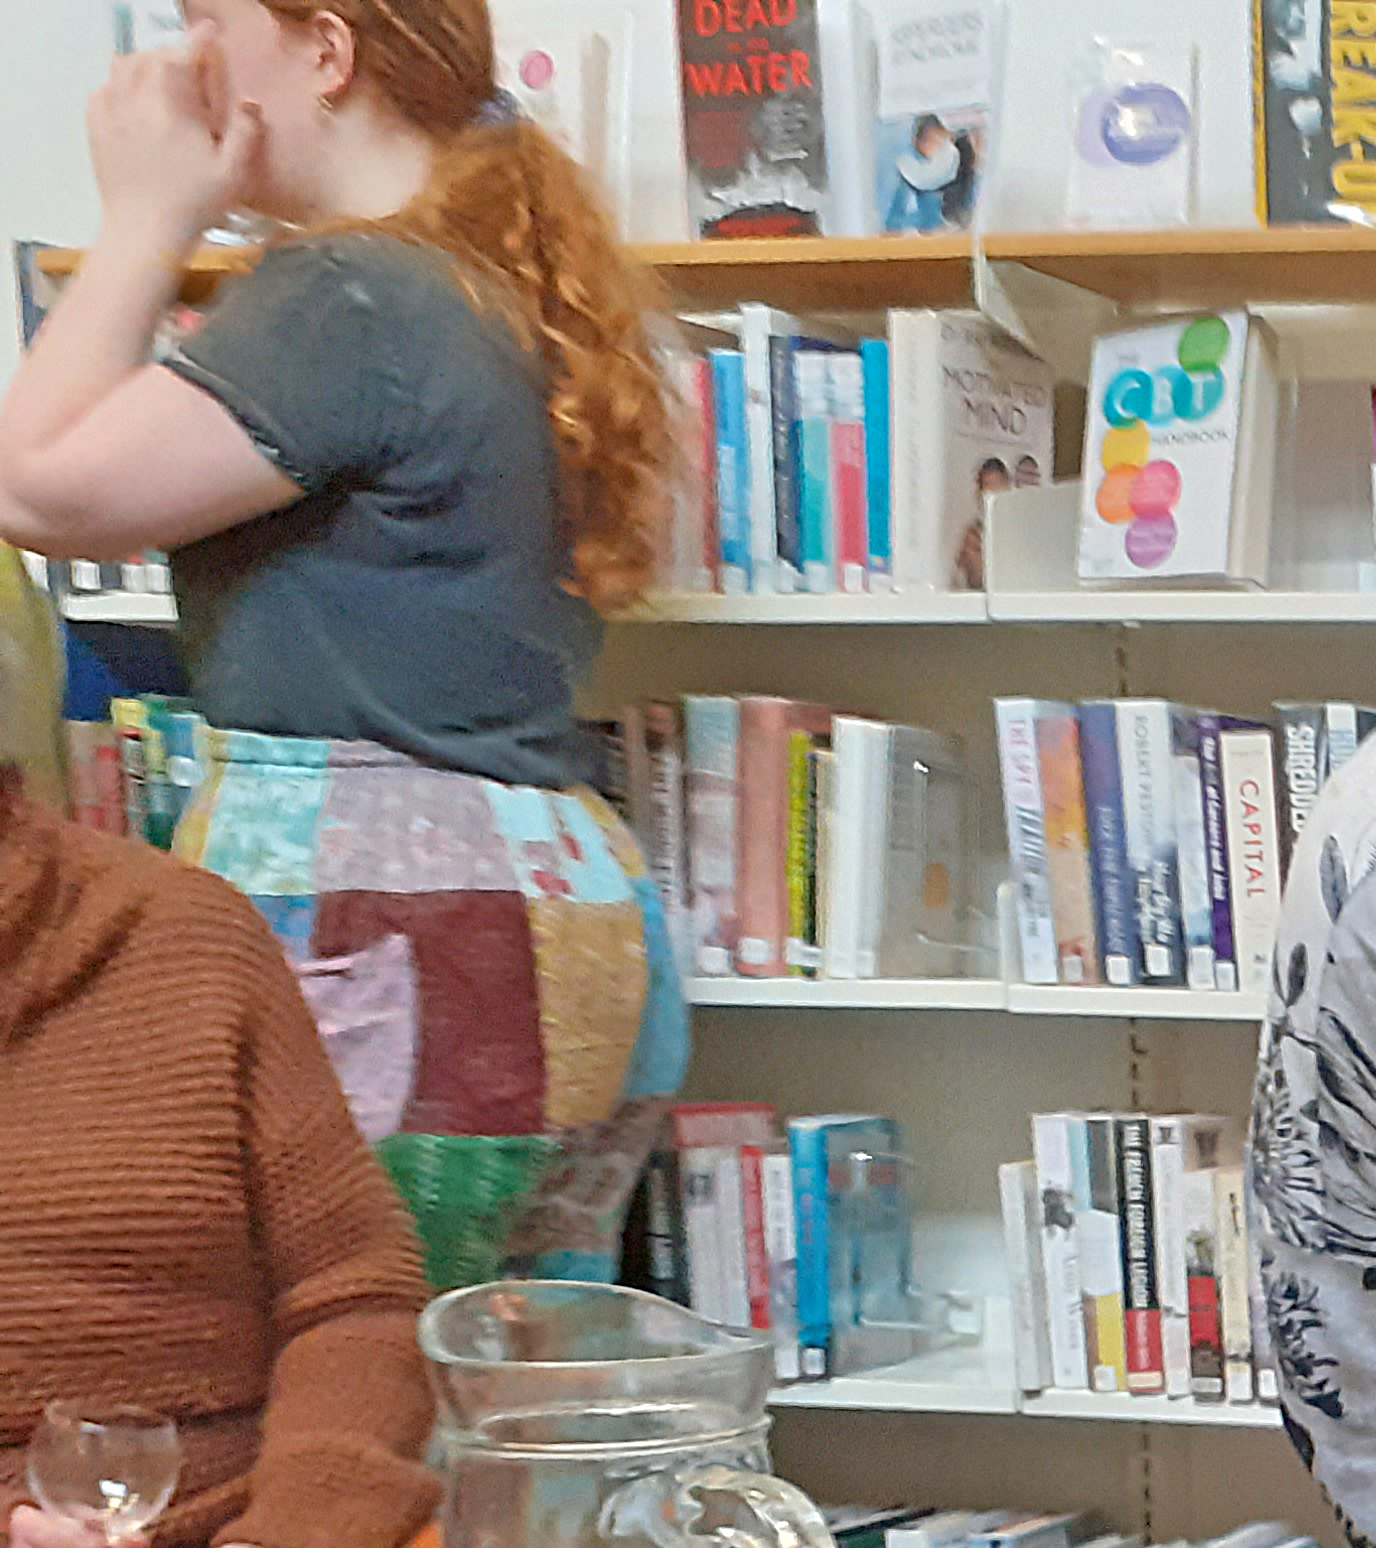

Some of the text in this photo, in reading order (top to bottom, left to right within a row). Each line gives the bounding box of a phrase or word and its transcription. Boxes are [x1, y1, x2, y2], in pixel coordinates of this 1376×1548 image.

[694, 0, 798, 37] DEAD
[686, 51, 814, 97] WATER
[961, 397, 1027, 436] MIND
[1238, 779, 1266, 899] CAPITAL
[1124, 1150, 1147, 1201] FRENCH
[1127, 1203, 1149, 1260] FOREIGN
[1130, 1261, 1151, 1309] LEGION
